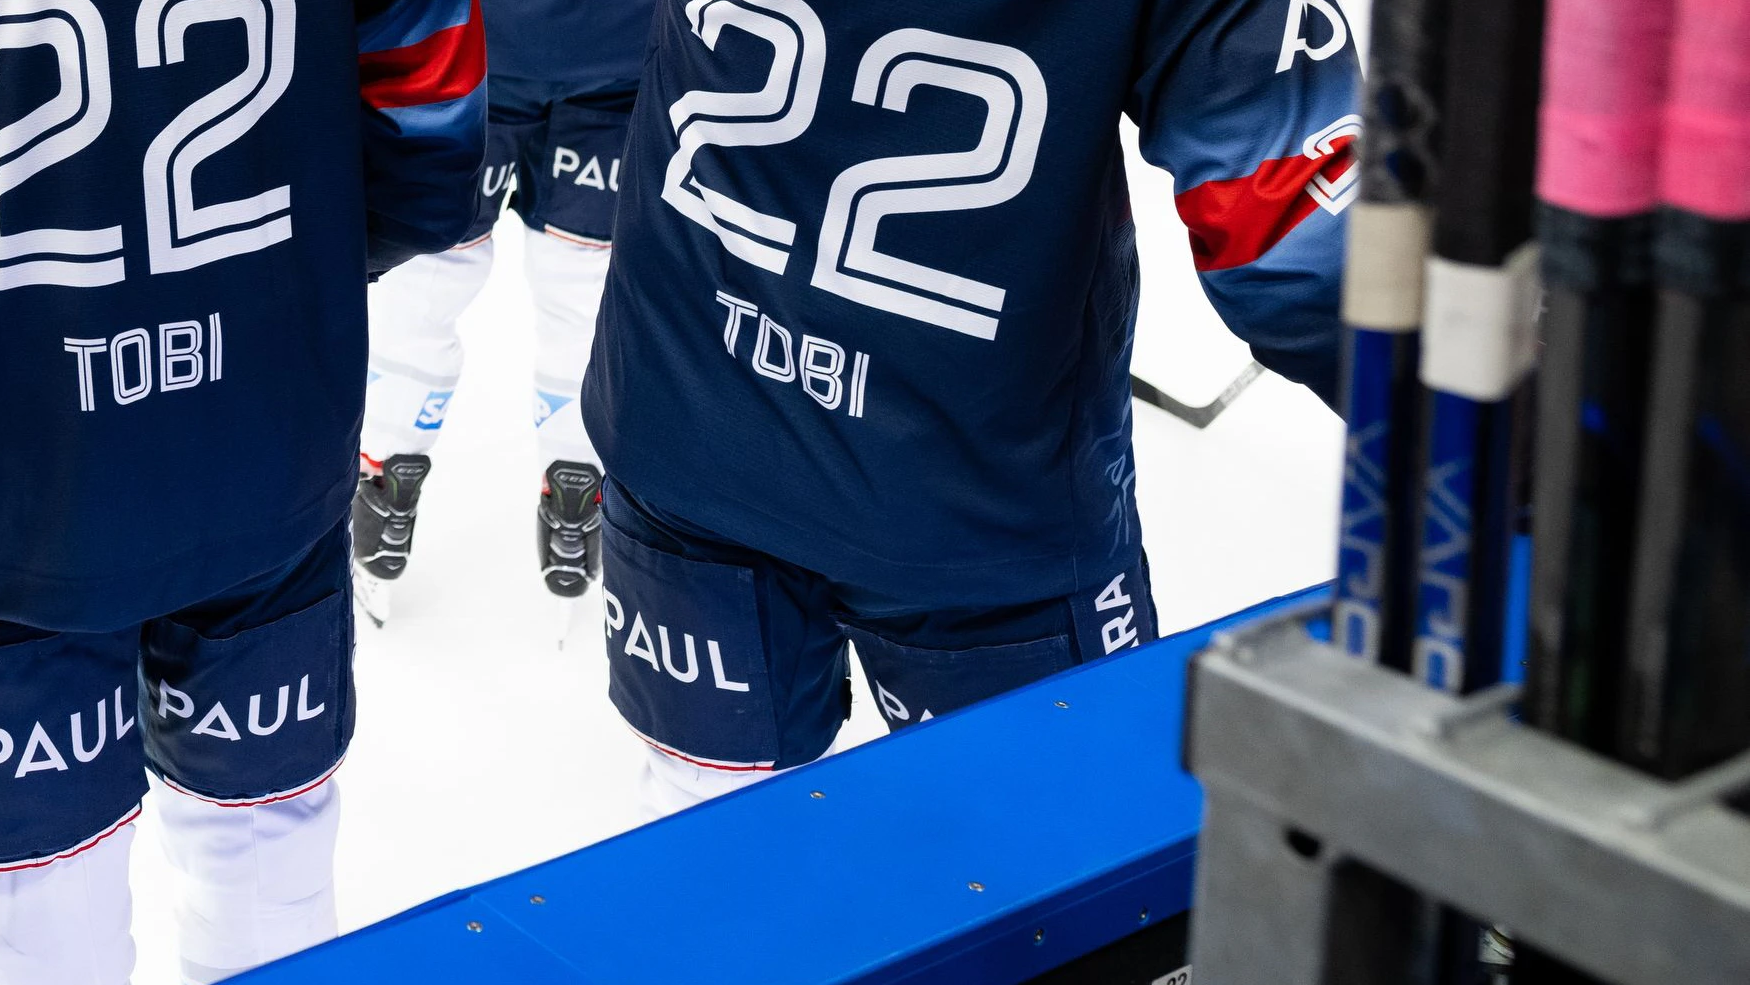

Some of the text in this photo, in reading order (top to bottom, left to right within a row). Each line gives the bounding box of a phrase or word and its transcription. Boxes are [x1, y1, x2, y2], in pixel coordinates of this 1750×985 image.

[63, 312, 225, 412] TOBI
[716, 289, 870, 418] TOBI
[603, 585, 750, 693] PAUL
[158, 673, 325, 742] PAUL
